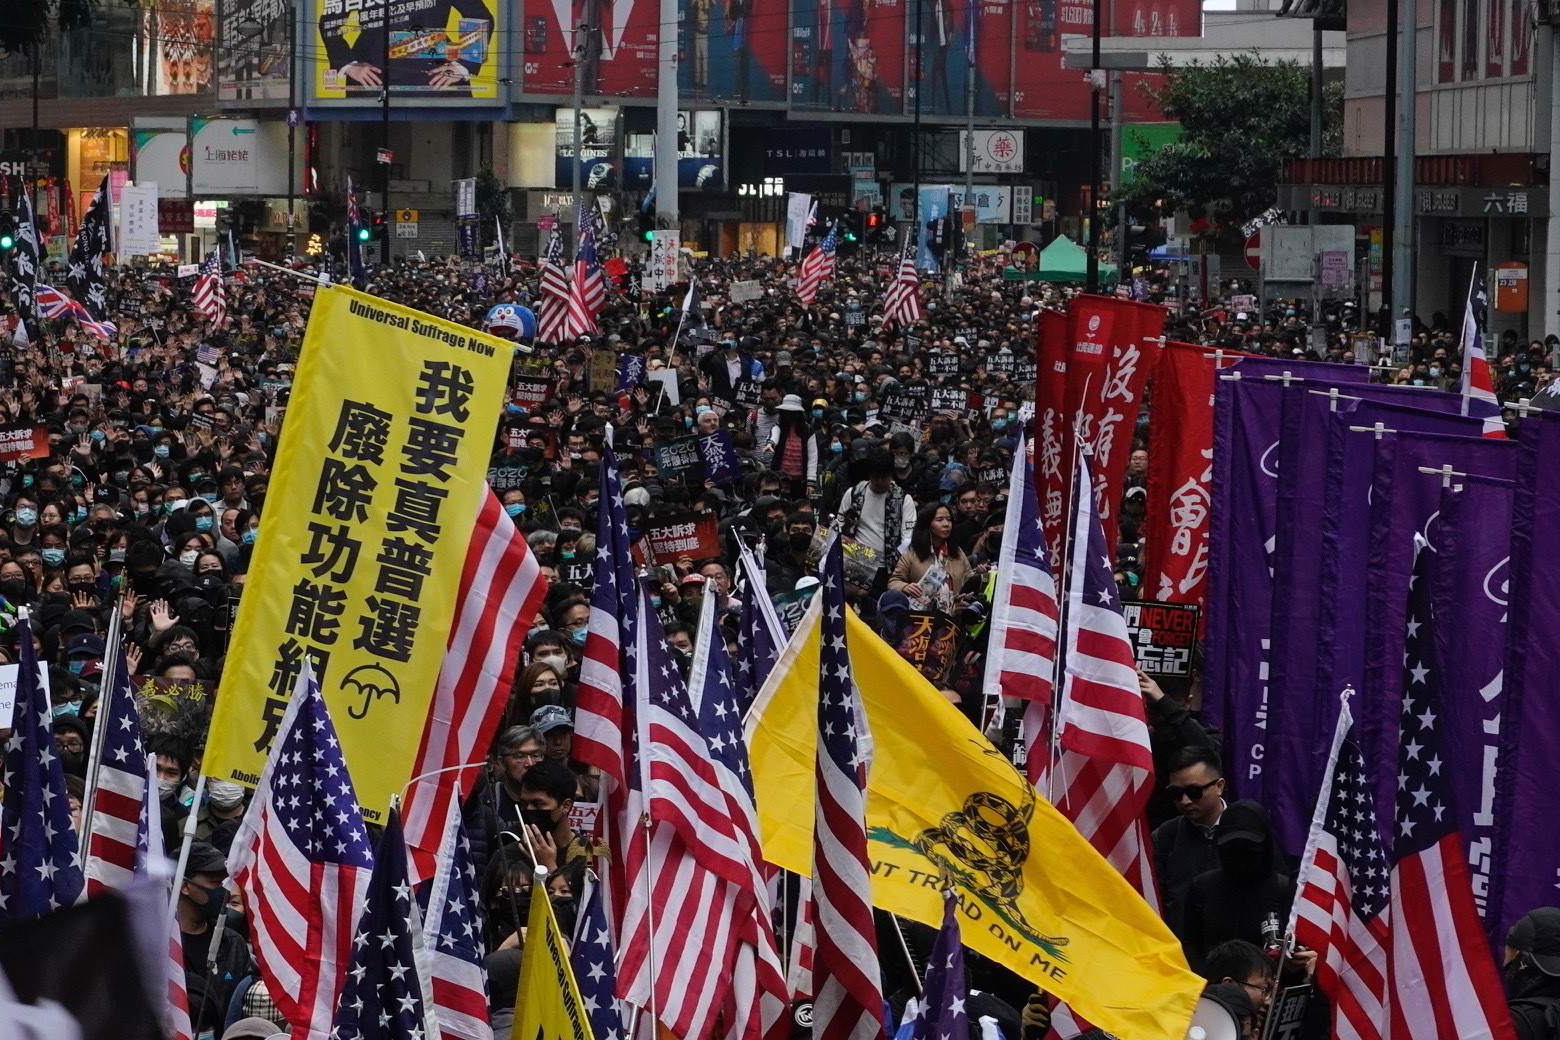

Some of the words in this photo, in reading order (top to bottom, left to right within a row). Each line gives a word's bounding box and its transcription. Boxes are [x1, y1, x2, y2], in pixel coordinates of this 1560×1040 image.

[563, 149, 607, 158] LOGINES
[994, 137, 1013, 158] 藥
[1344, 192, 1388, 214] 六福
[350, 299, 411, 335] Universal
[412, 319, 465, 349] Suffrage
[467, 337, 495, 358] Now
[932, 399, 966, 410] 缺一不可
[933, 388, 966, 400] 五大訴求
[353, 359, 473, 663] 我要真普選
[650, 522, 696, 541] 五大訴求
[1141, 606, 1194, 632] NEVER
[1153, 629, 1193, 648] FORGET
[1137, 644, 1188, 676] 忘記
[908, 871, 983, 921] TRAD
[988, 924, 1022, 951] ON
[1029, 952, 1068, 984] ME
